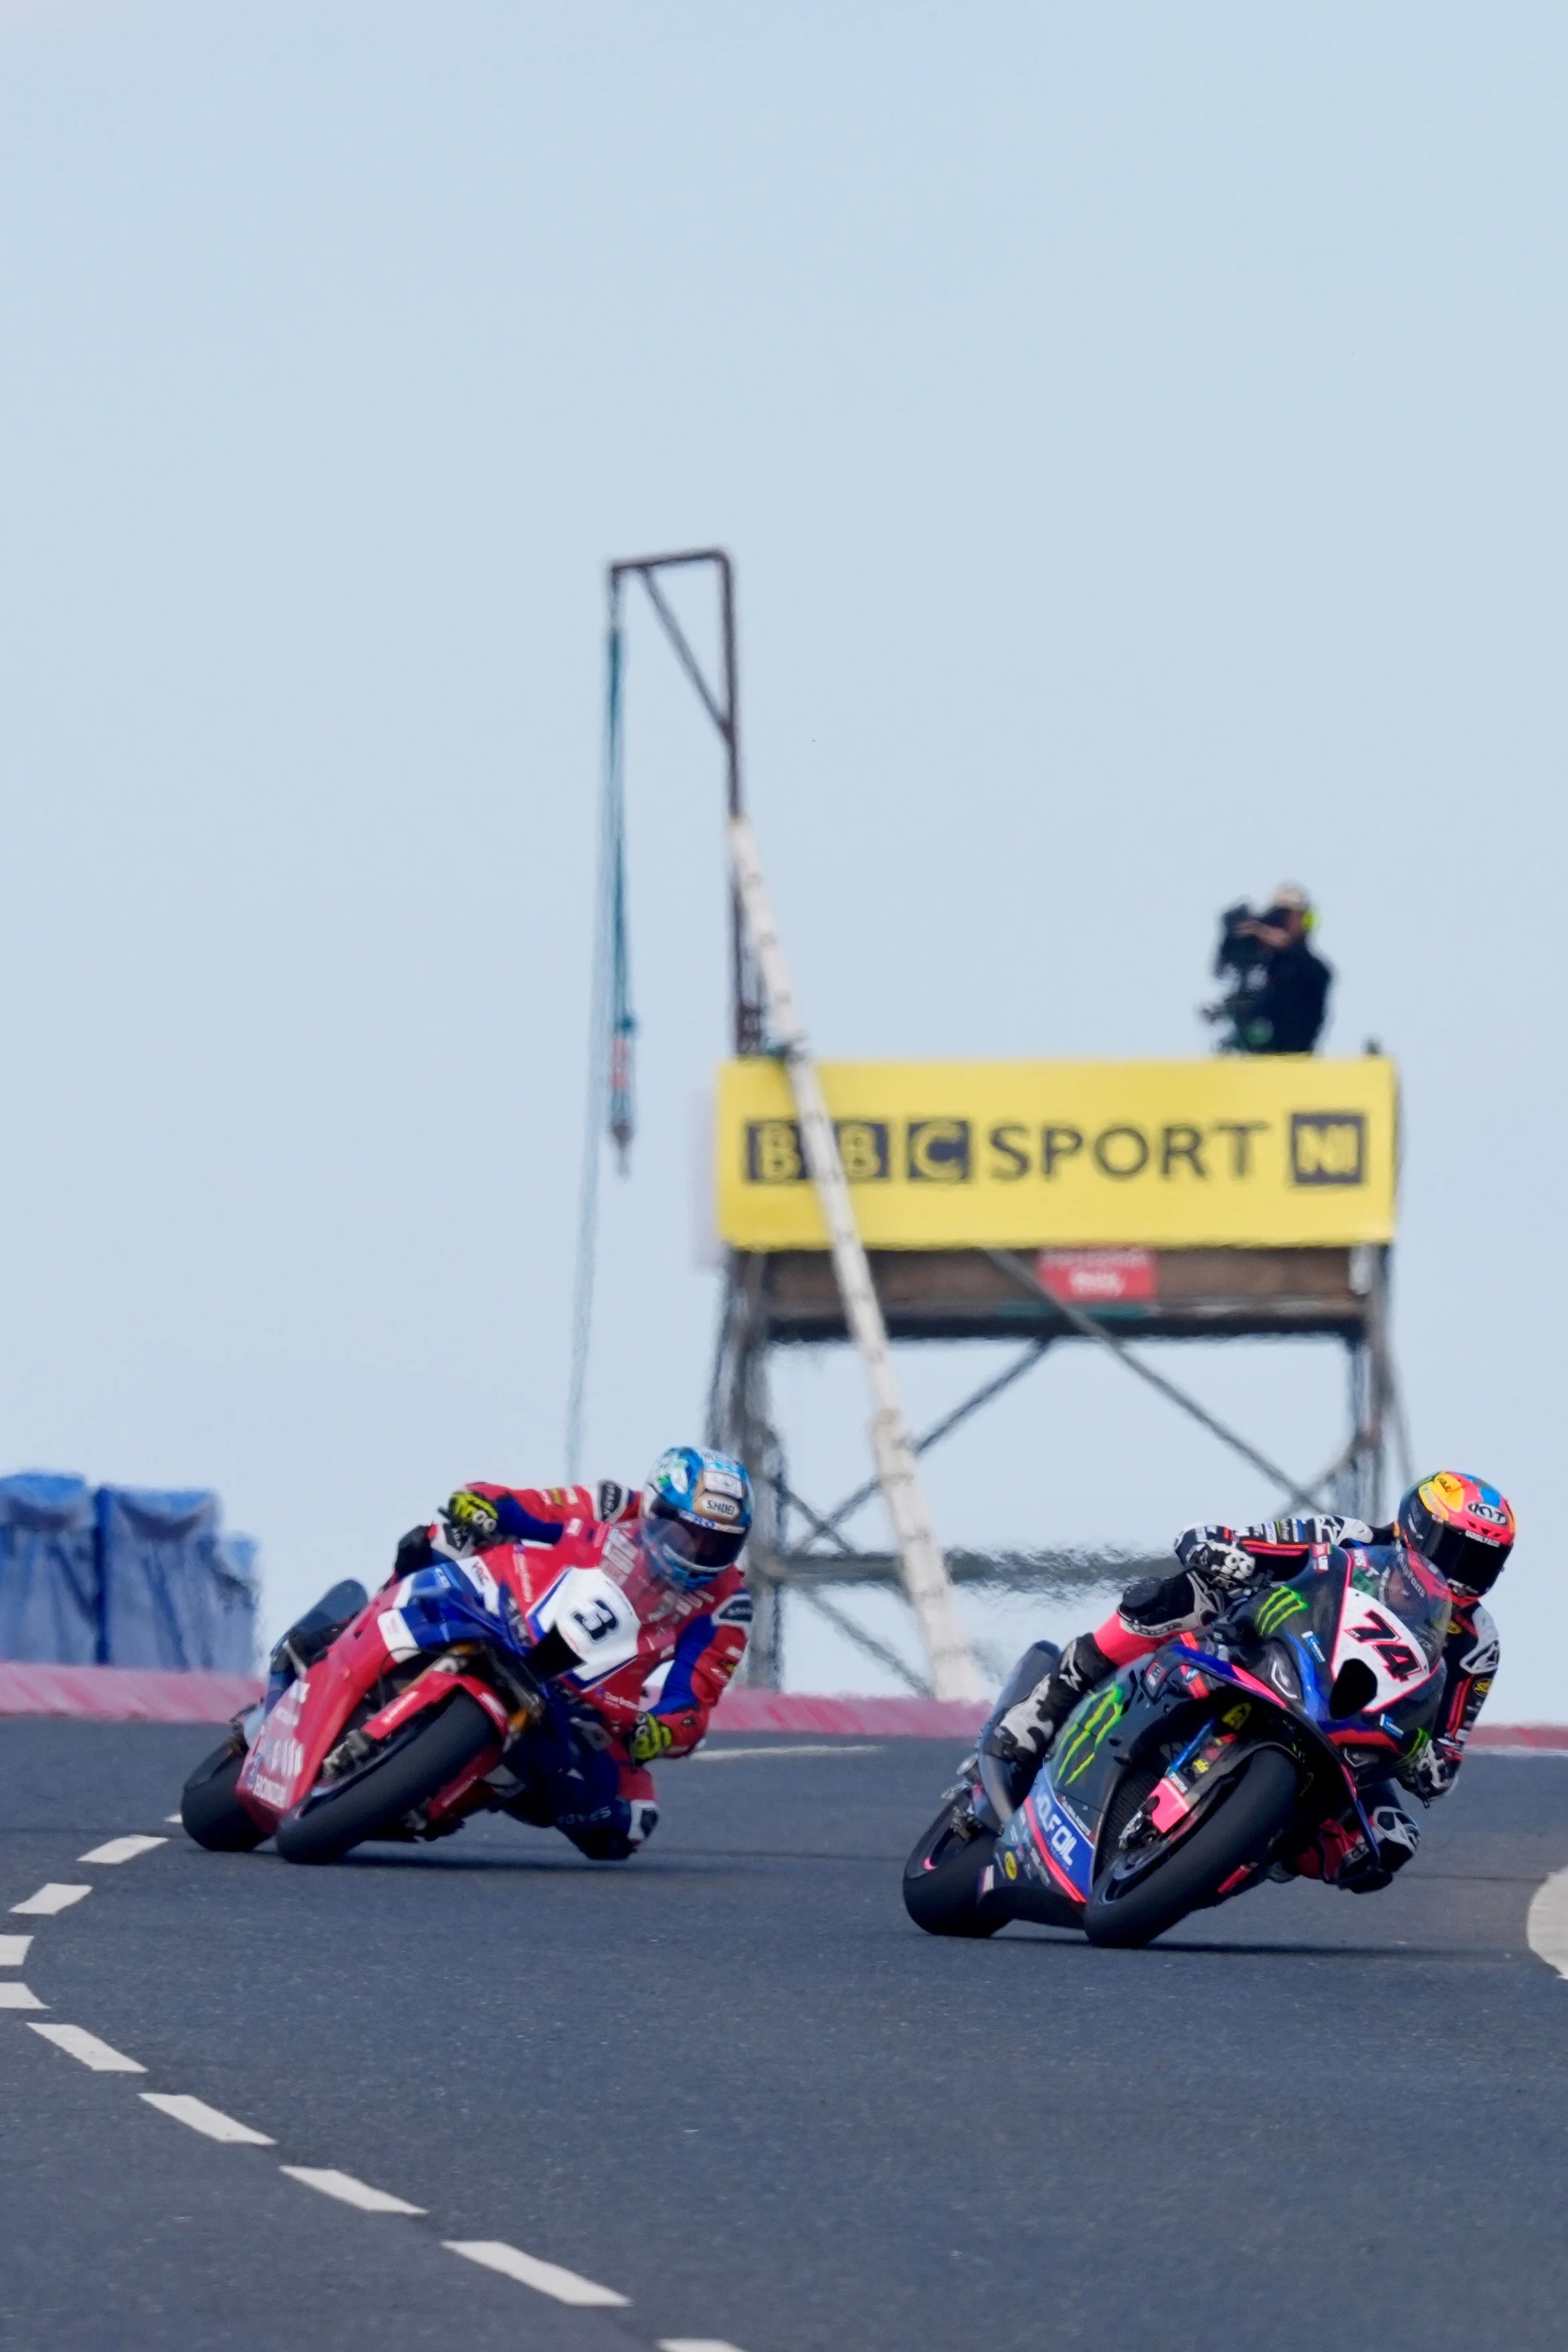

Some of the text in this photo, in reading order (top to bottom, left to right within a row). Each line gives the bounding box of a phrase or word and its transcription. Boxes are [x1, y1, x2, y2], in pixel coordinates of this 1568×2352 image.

[758, 1121, 1359, 1180] BBC SPORT NI
[706, 1500, 736, 1516] SHOEI
[1472, 1503, 1505, 1522] KYT
[573, 1599, 619, 1645] 3
[1345, 1609, 1423, 1682] 74
